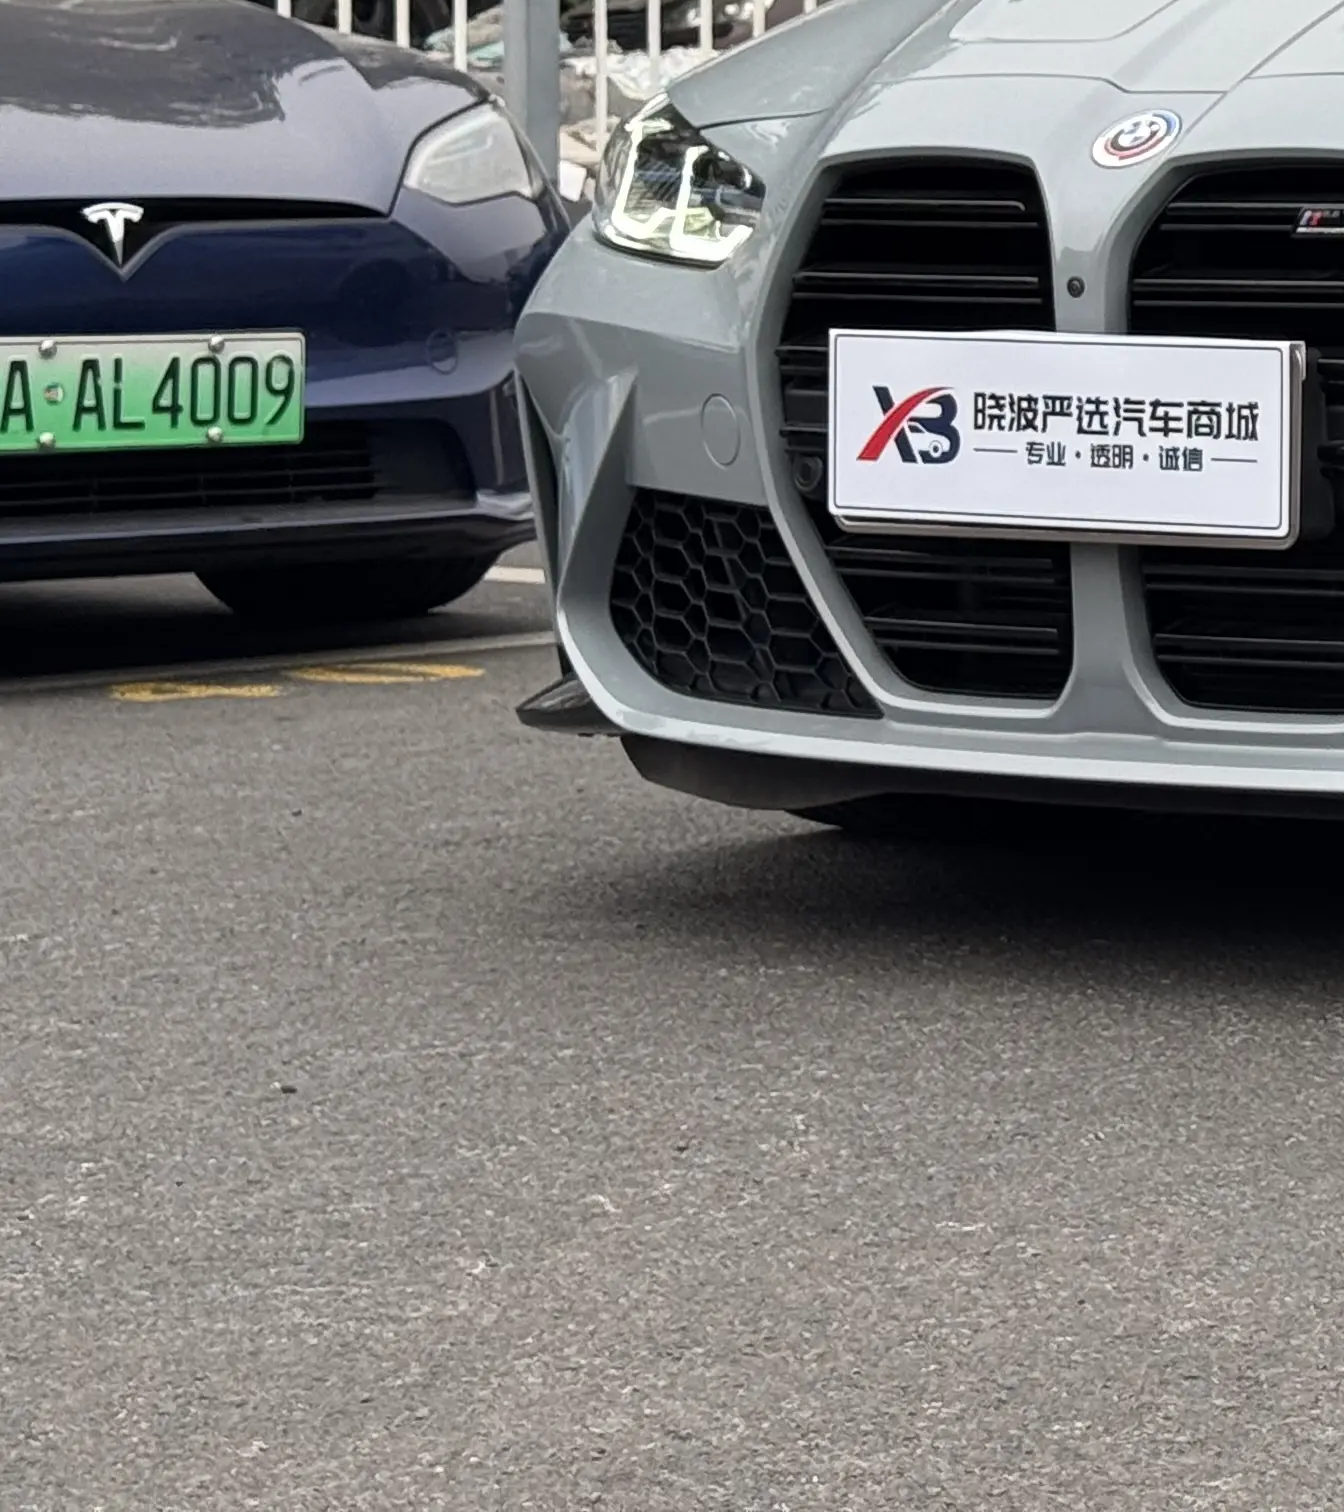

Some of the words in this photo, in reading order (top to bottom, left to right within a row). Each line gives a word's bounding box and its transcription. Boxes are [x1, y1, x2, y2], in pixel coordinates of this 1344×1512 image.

[973, 391, 1259, 442] 晓波严选汽车商城
